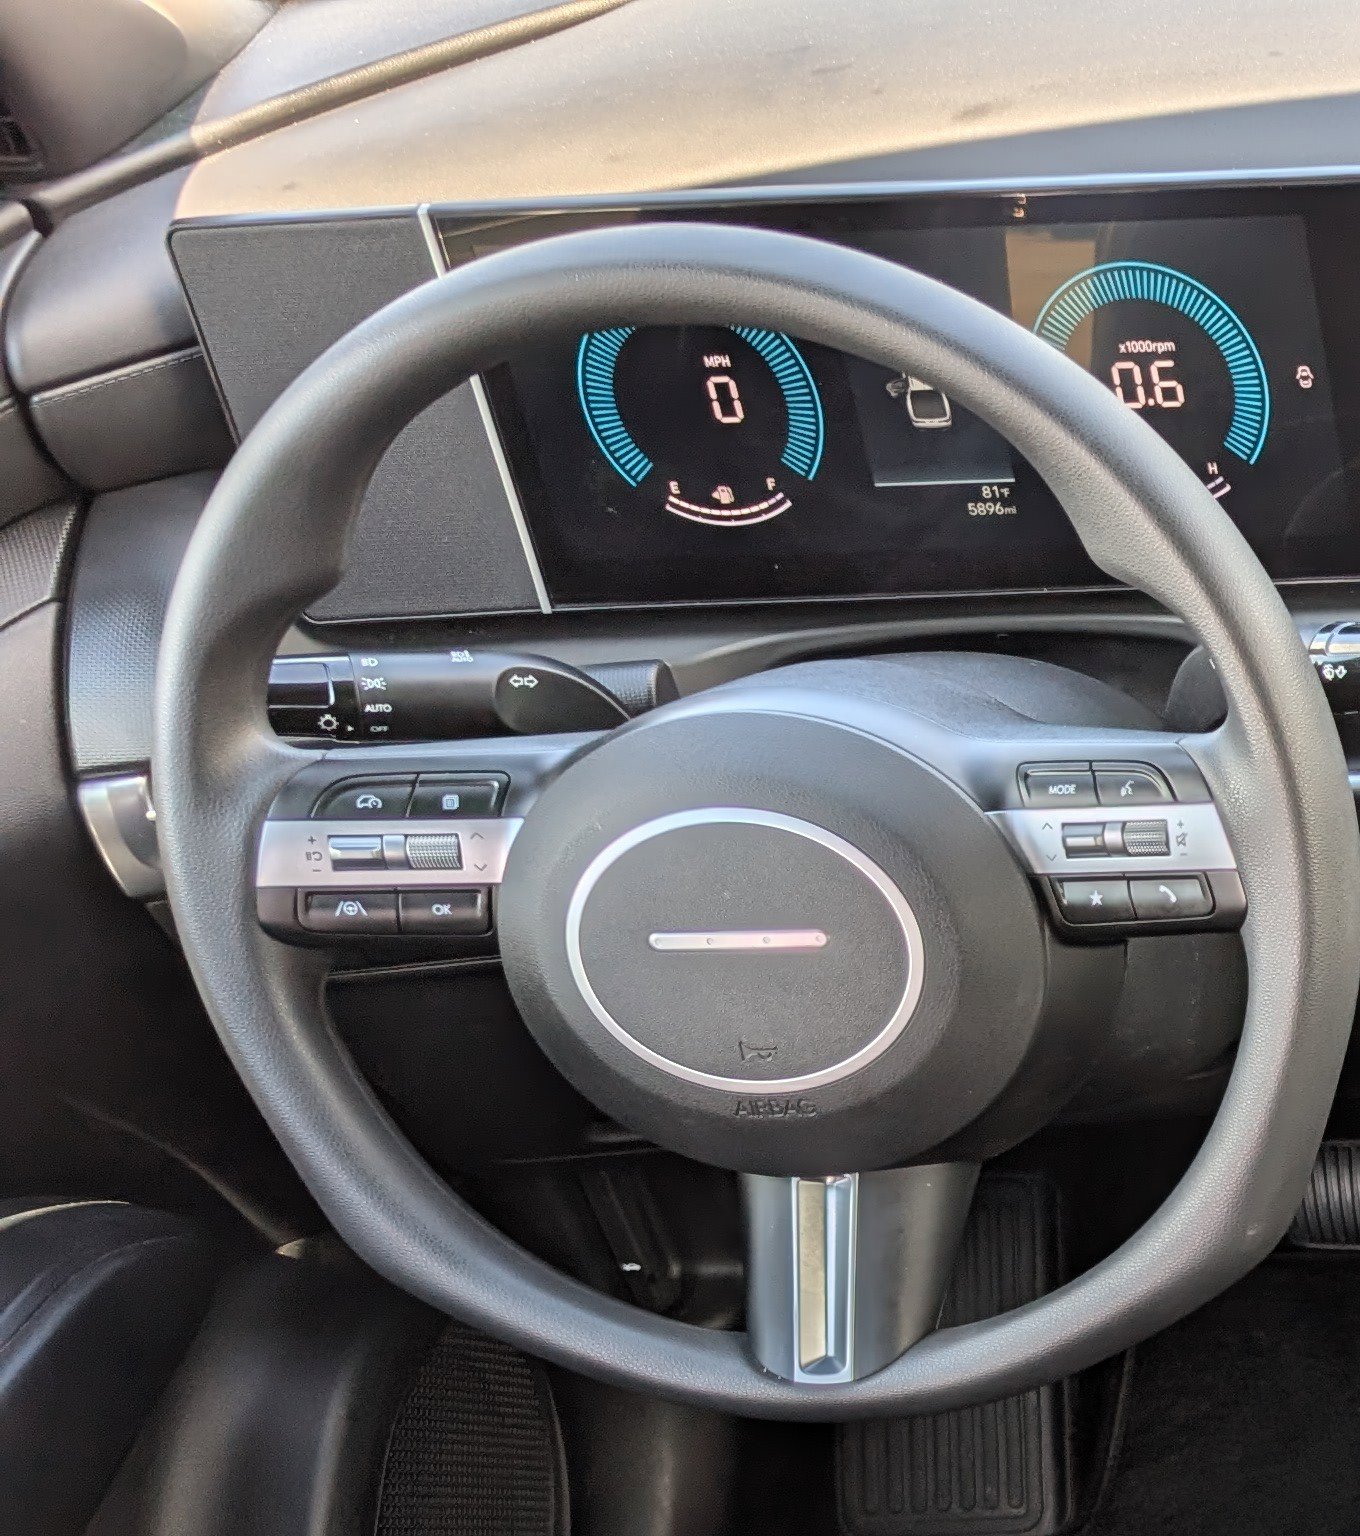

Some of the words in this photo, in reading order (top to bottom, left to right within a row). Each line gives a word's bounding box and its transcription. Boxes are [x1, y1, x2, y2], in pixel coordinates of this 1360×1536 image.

[1119, 340, 1176, 354] x1000rpm
[703, 354, 732, 368] MPH
[1111, 360, 1185, 409] 0.6
[706, 375, 744, 423] 0
[669, 480, 680, 494] E
[765, 477, 776, 491] F
[968, 502, 1017, 516] 5896mi
[364, 703, 393, 713] AUTO
[1048, 784, 1077, 795] MODE
[431, 903, 453, 916] OK
[733, 1098, 818, 1118] AIRBAG
